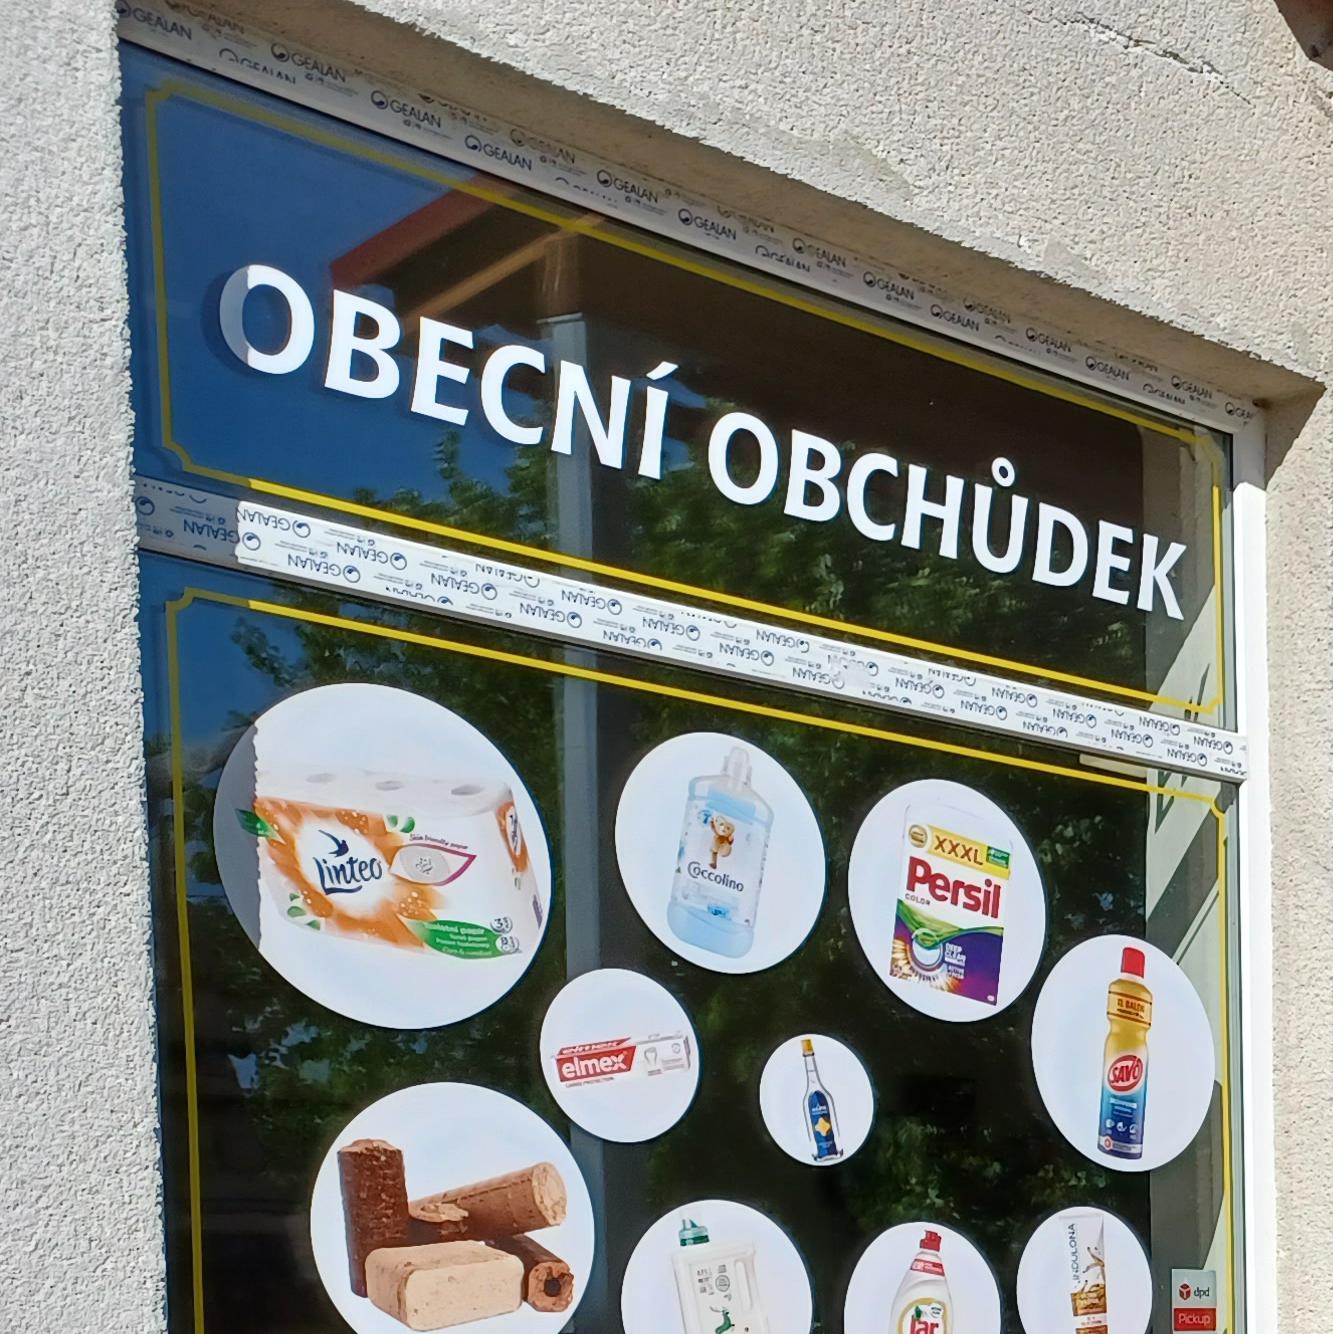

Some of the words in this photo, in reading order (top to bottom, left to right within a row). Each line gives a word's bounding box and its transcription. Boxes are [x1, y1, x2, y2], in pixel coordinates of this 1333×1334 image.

[132, 6, 192, 40] GEALAN
[291, 51, 347, 83] GEALAN
[390, 99, 442, 129] GEALAN
[482, 144, 532, 171] GEALAN
[614, 178, 658, 203] GEALAN
[693, 216, 737, 241] GEALAN
[878, 277, 915, 301] GEALAN
[943, 312, 979, 333] GEALAN
[1037, 328, 1072, 352] GEALAN
[1096, 359, 1131, 382] GEALAN
[219, 264, 679, 480] OBECNÍ
[708, 411, 1190, 620] OBCHŮDEK
[183, 519, 240, 544] GEALAN
[237, 509, 291, 531] GEALAN
[336, 541, 388, 564] GEALAN
[288, 553, 341, 577] GEALAN
[431, 572, 480, 595] GEALAN
[561, 589, 606, 610] GEALAN
[520, 602, 566, 624] GEALAN
[642, 616, 685, 637] GEALAN
[719, 642, 760, 662] GEALAN
[793, 667, 832, 686] GEALAN
[895, 677, 934, 697] GEALAN
[991, 687, 1027, 706] GEALAN
[960, 700, 997, 718] GEALAN
[1053, 709, 1087, 727] GEALAN
[934, 835, 984, 866] XXXL
[313, 856, 382, 895] Linteo
[688, 861, 745, 892] Coccolino
[907, 856, 1001, 919] Persil
[905, 893, 931, 906] COLOR
[562, 1054, 627, 1078] elmex
[1111, 1057, 1142, 1084] SAVO
[1194, 1287, 1210, 1298] dpd
[1178, 1314, 1211, 1327] Pickup
